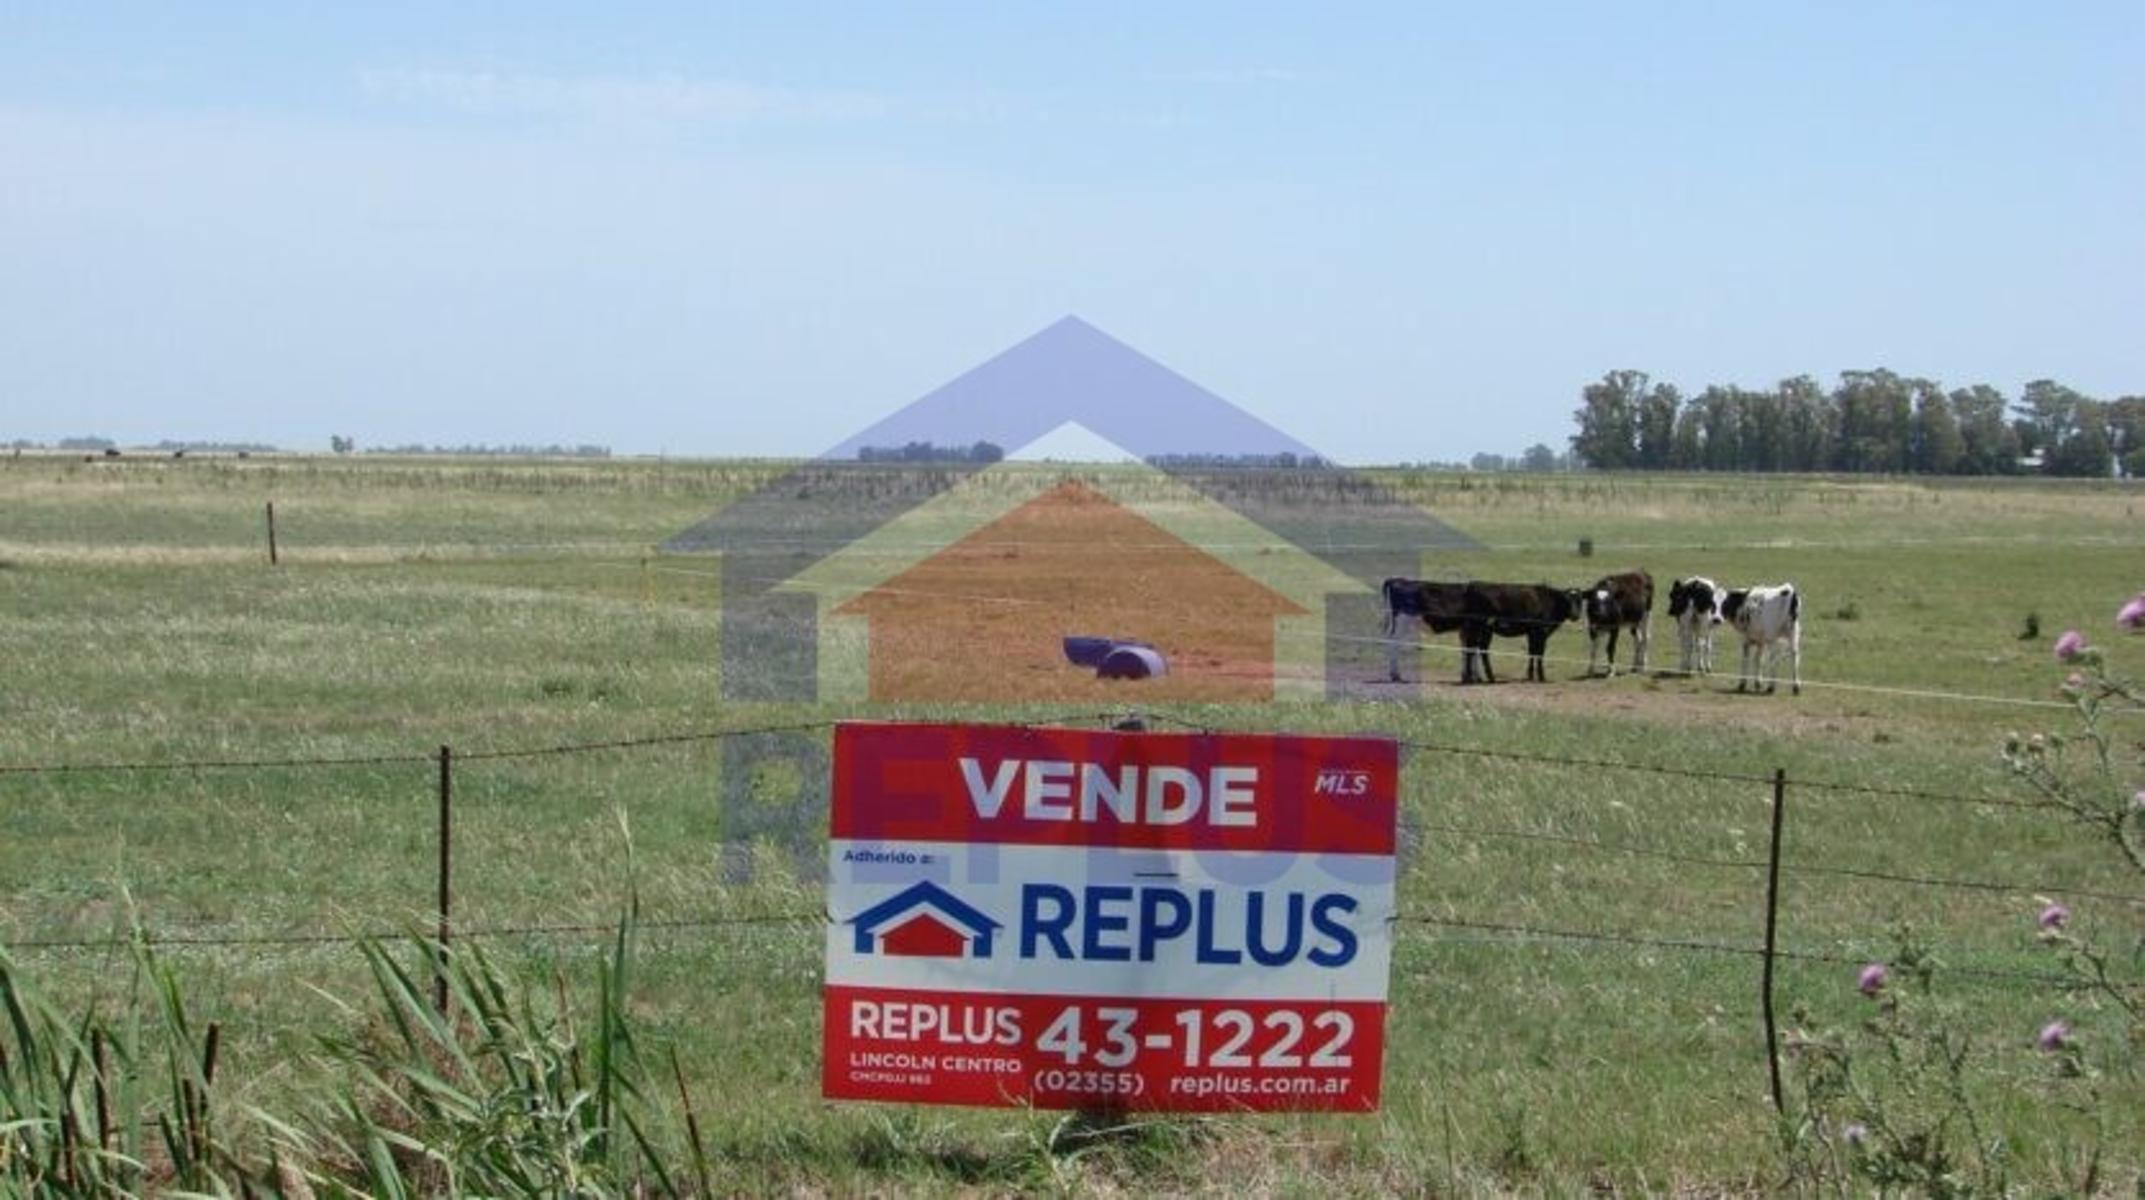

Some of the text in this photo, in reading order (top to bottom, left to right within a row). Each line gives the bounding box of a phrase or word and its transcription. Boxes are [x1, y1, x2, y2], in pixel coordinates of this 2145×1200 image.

[959, 758, 1259, 827] VENDE
[1314, 775, 1369, 795] MLS
[842, 850, 916, 864] Adherido
[1019, 883, 1359, 968] REPLUS
[851, 1000, 1022, 1045] REPLUS
[1036, 1006, 1354, 1068] 43-1222
[850, 1052, 1022, 1073] LINCOLN CENTRO
[1034, 1070, 1145, 1096] (02355)
[1171, 1072, 1351, 1098] replus.com.ar
